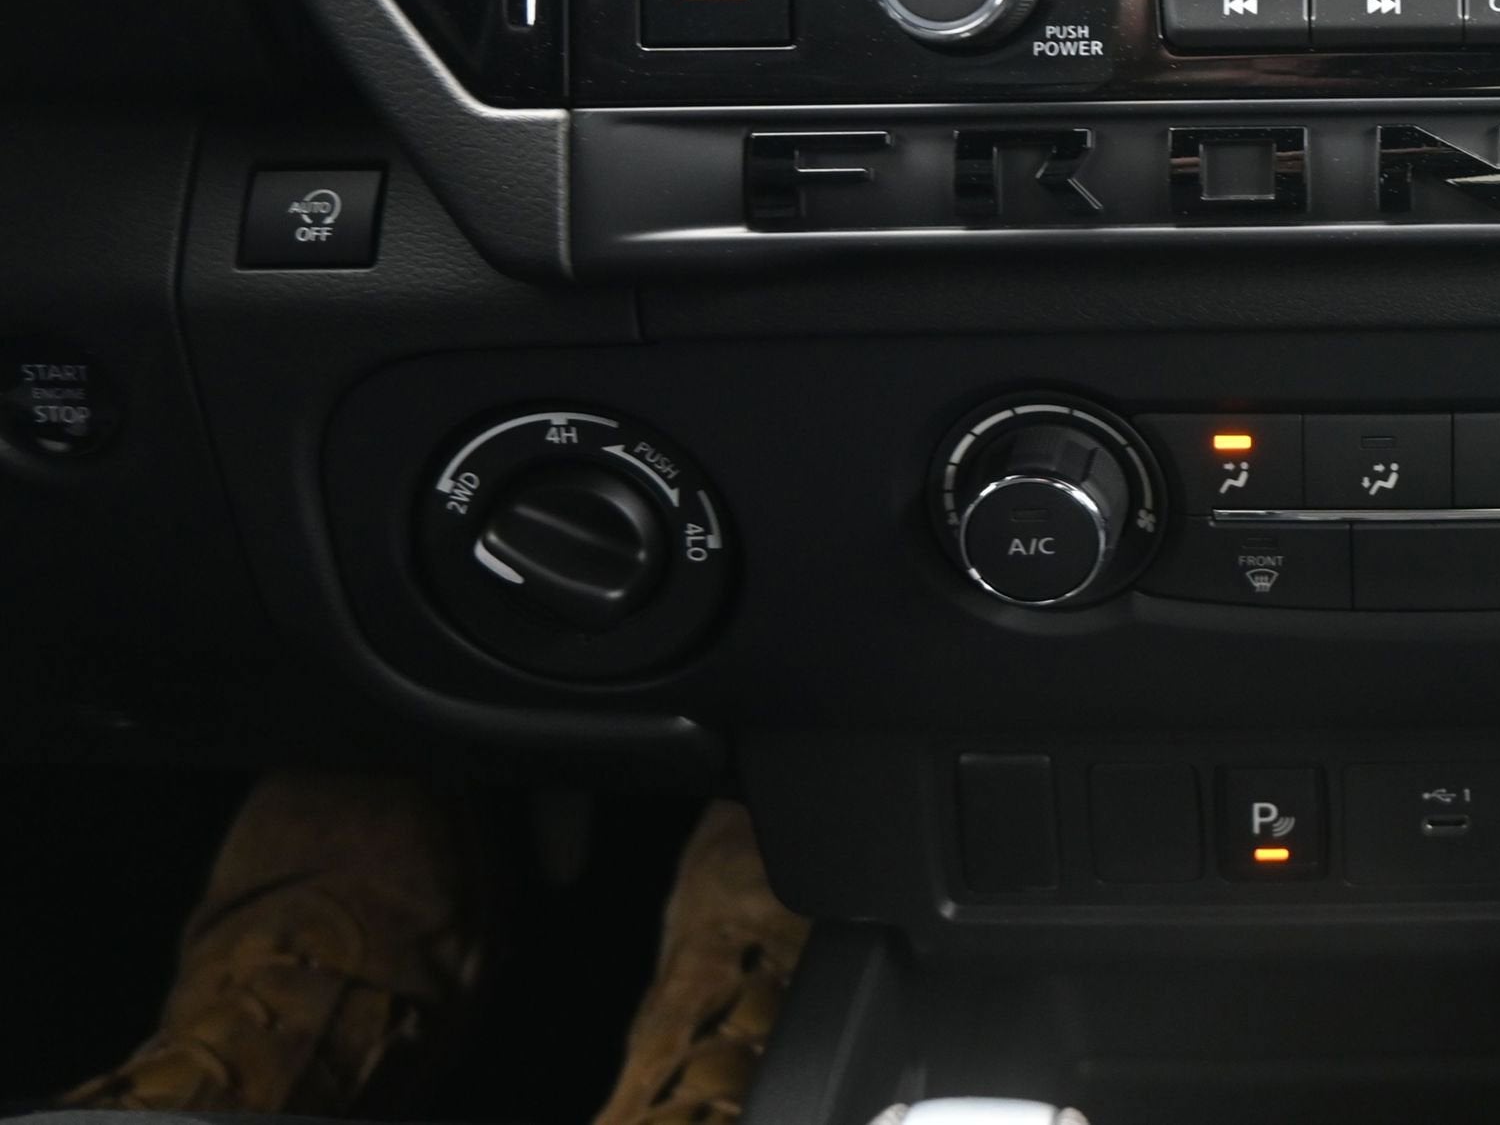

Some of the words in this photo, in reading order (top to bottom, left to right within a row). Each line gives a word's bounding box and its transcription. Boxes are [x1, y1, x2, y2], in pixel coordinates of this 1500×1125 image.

[1045, 24, 1090, 40] PUSH
[1032, 40, 1104, 58] POWER
[294, 226, 334, 243] OFF
[20, 363, 89, 382] START
[34, 405, 91, 424] STOP
[544, 425, 579, 445] 4H
[633, 440, 681, 480] PUSH
[446, 471, 481, 515] 2WD
[685, 522, 709, 563] 4LO
[1008, 536, 1055, 556] A/C
[1238, 554, 1284, 568] FRONT
